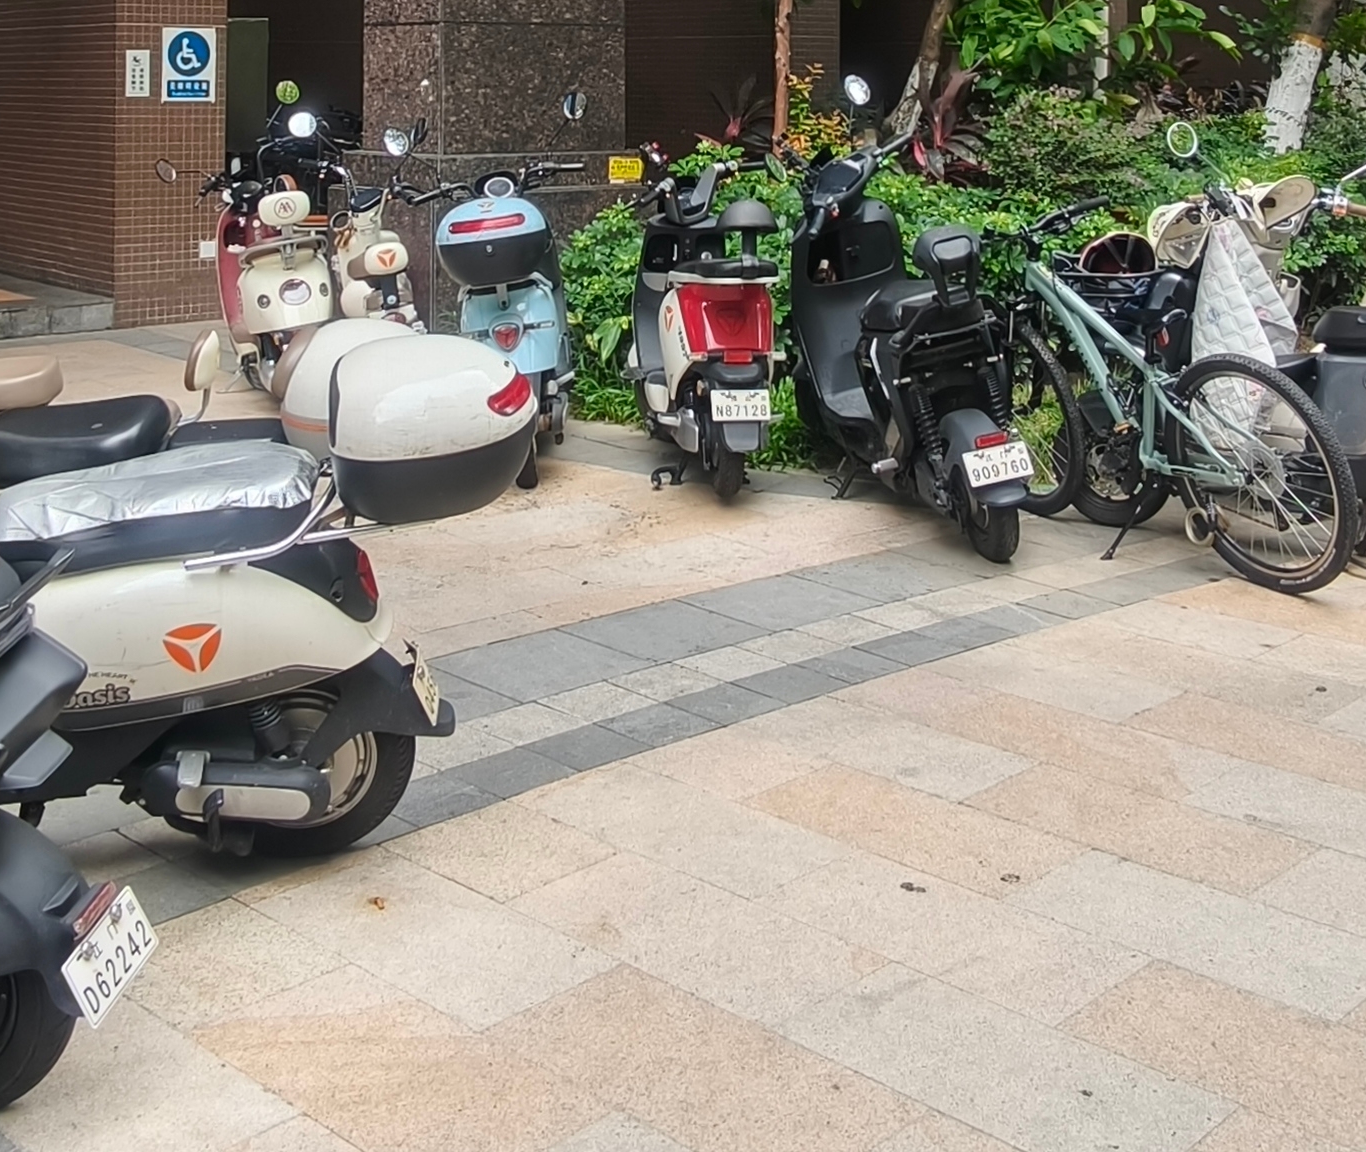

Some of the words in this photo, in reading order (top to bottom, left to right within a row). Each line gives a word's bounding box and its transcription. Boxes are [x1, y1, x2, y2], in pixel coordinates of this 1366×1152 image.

[716, 403, 768, 418] N87128
[972, 457, 1029, 482] 909760
[83, 920, 152, 1014] D62242
